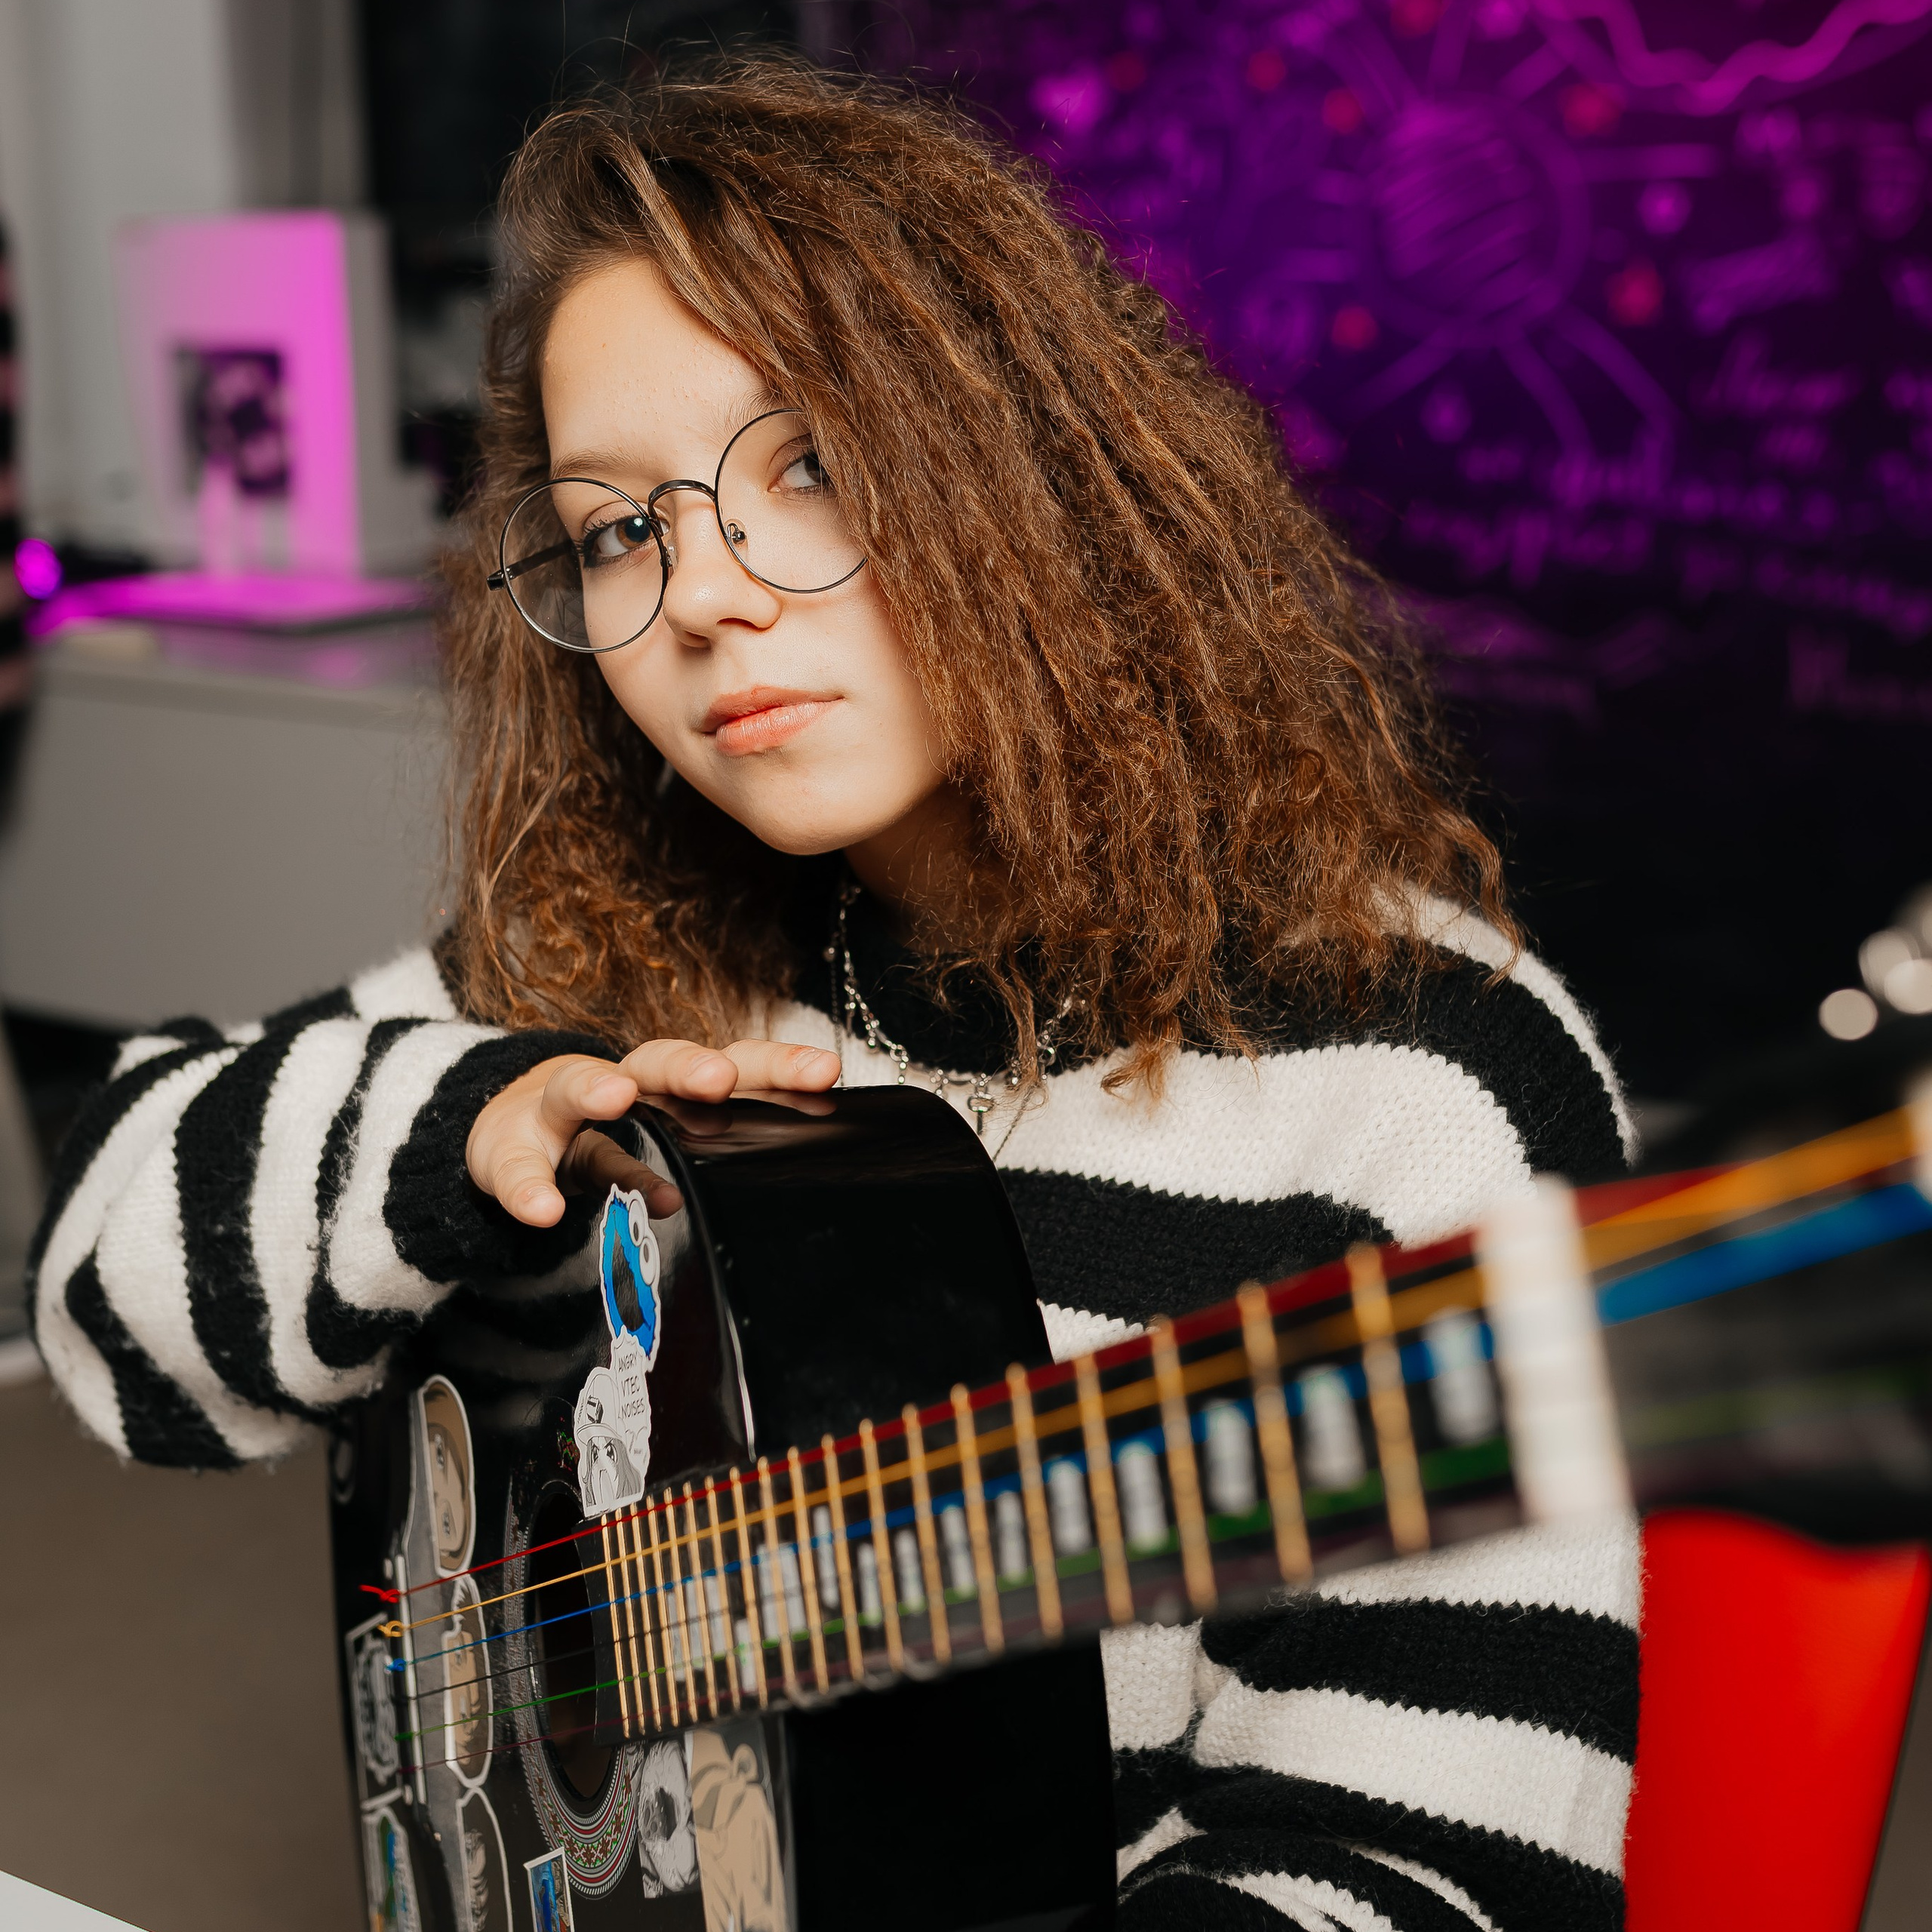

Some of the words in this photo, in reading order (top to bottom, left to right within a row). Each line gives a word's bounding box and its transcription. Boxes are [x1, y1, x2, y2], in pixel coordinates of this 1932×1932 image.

[618, 1352, 638, 1373] ANGRY
[621, 1375, 641, 1398] VTEC
[621, 1398, 645, 1420] NOISES
